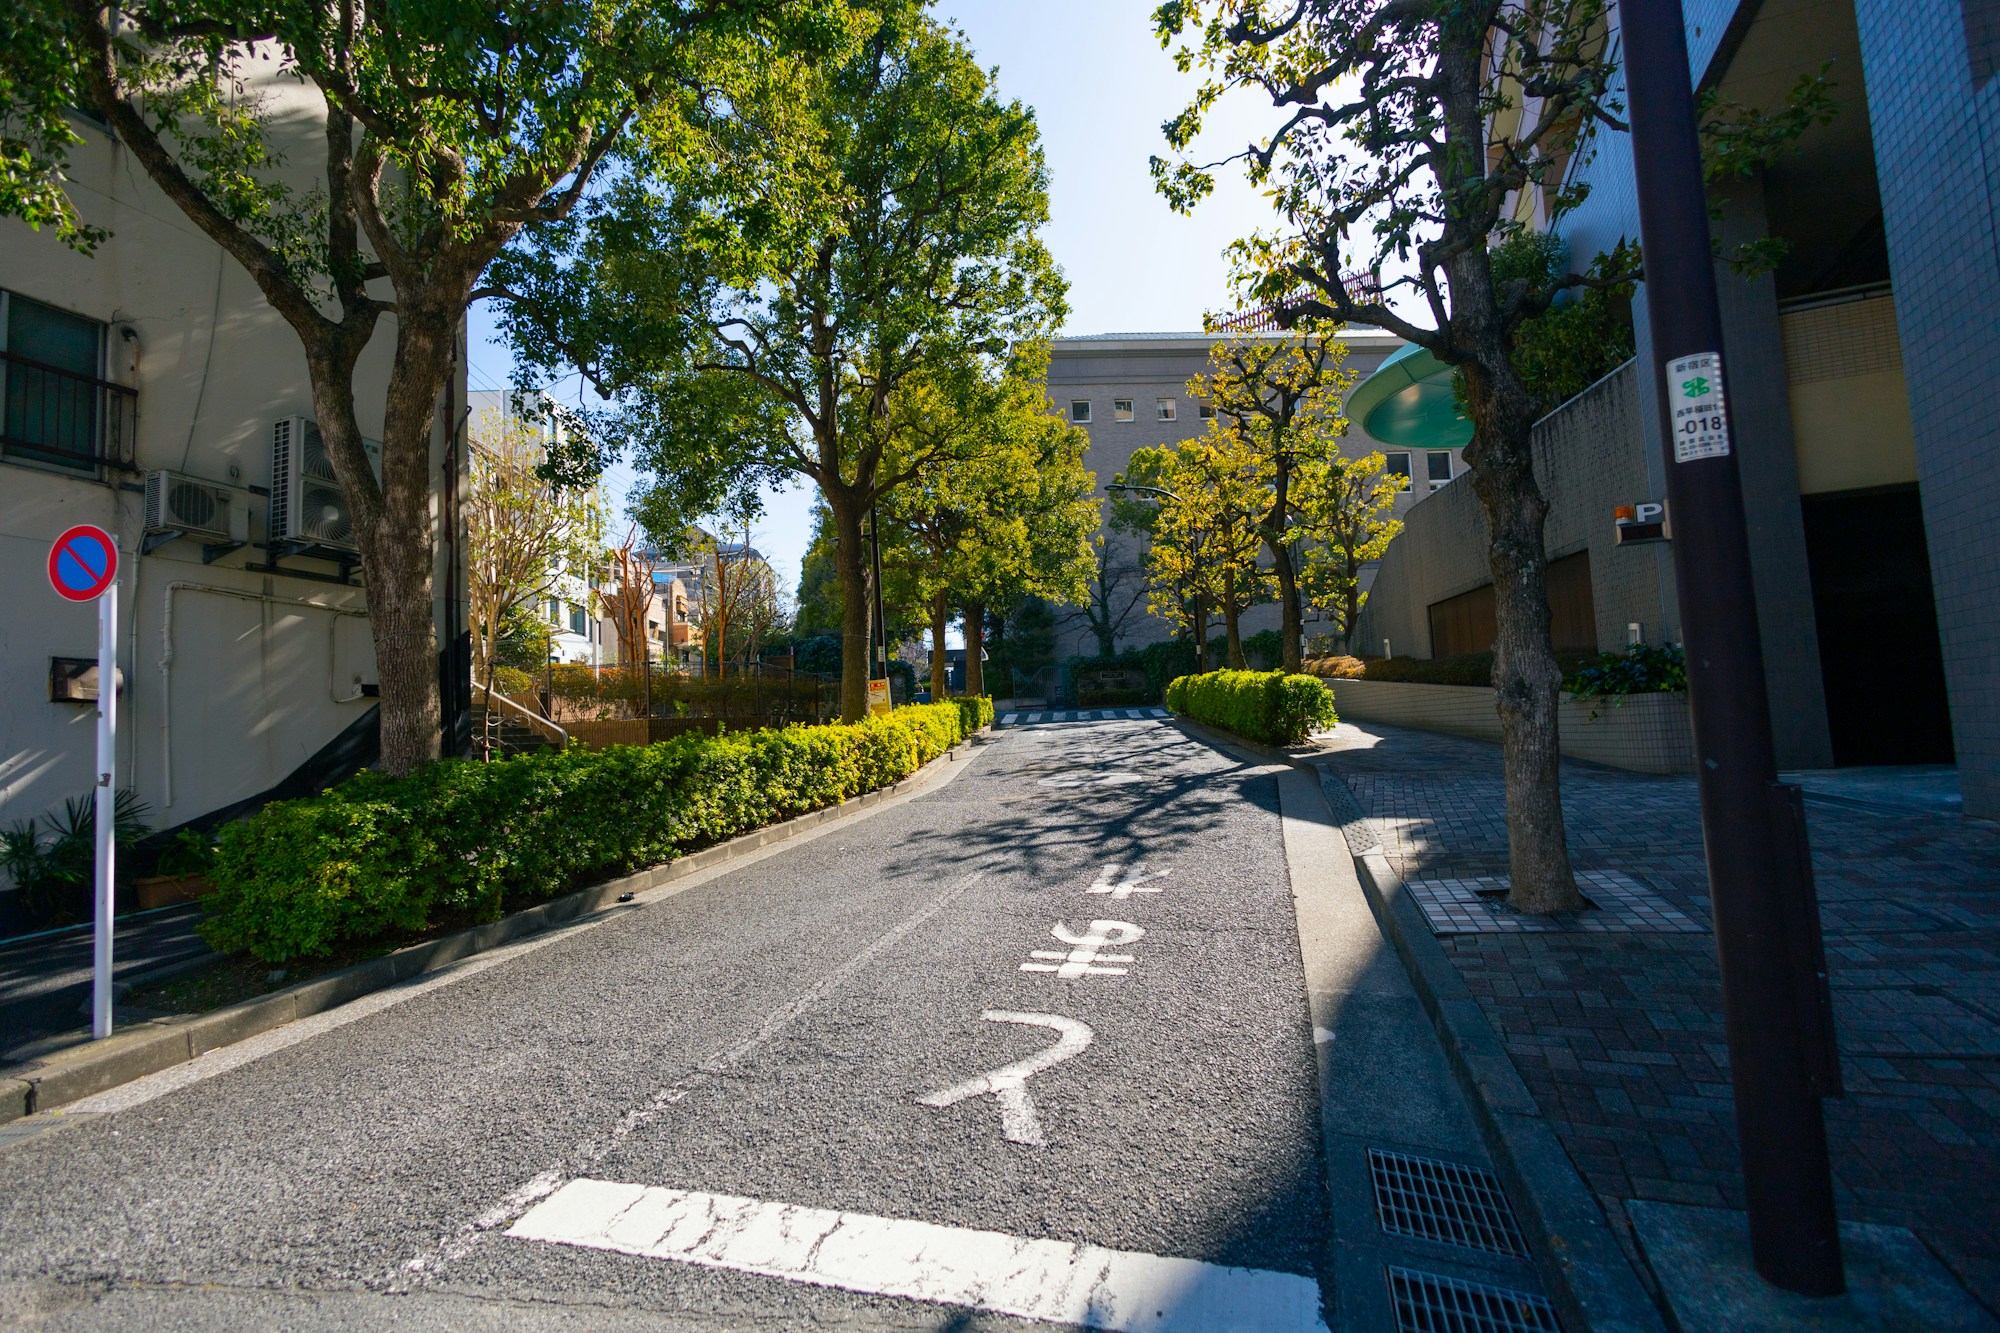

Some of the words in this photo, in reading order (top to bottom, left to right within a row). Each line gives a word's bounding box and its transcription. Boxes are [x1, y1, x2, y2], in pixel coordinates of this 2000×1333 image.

[1675, 358, 1711, 373] 新宿区
[1678, 416, 1722, 434] -018
[1636, 503, 1663, 523] P
